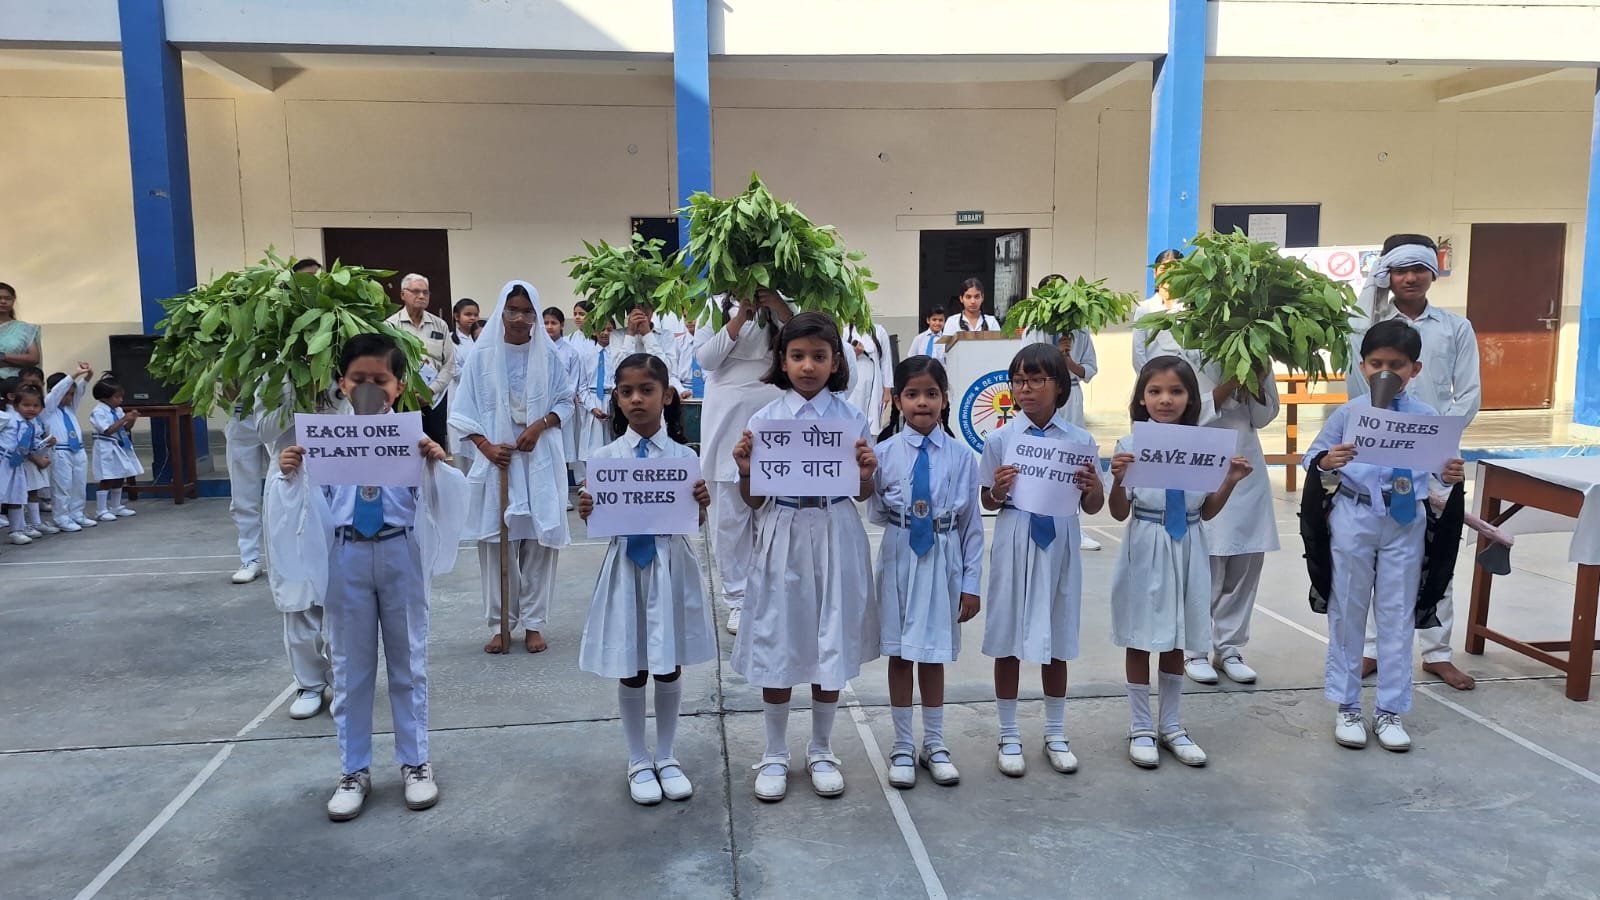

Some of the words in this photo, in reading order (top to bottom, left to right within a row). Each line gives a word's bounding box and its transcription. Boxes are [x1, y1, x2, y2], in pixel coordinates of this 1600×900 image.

[958, 214, 982, 222] LIBRARY
[982, 378, 993, 387] BE
[993, 374, 1004, 382] YE
[306, 425, 359, 438] EACH
[362, 424, 400, 437] ONE
[1357, 415, 1381, 430] NO
[1384, 420, 1439, 435] TREES
[759, 431, 792, 449] एक
[802, 424, 843, 447] पौधा
[1353, 435, 1377, 448] NO
[1379, 438, 1416, 449] LIFE
[308, 446, 370, 458] PLANT
[374, 445, 411, 457] ONE
[1016, 444, 1057, 460] GROW
[1139, 448, 1187, 464] SAVE
[1188, 452, 1216, 467] ME
[596, 469, 628, 482] CUT
[632, 468, 688, 482] GREED
[759, 460, 792, 479] एक
[801, 460, 842, 477] वादा
[1049, 469, 1082, 487] FUTU
[596, 491, 618, 505] NO
[622, 490, 675, 505] TREES
